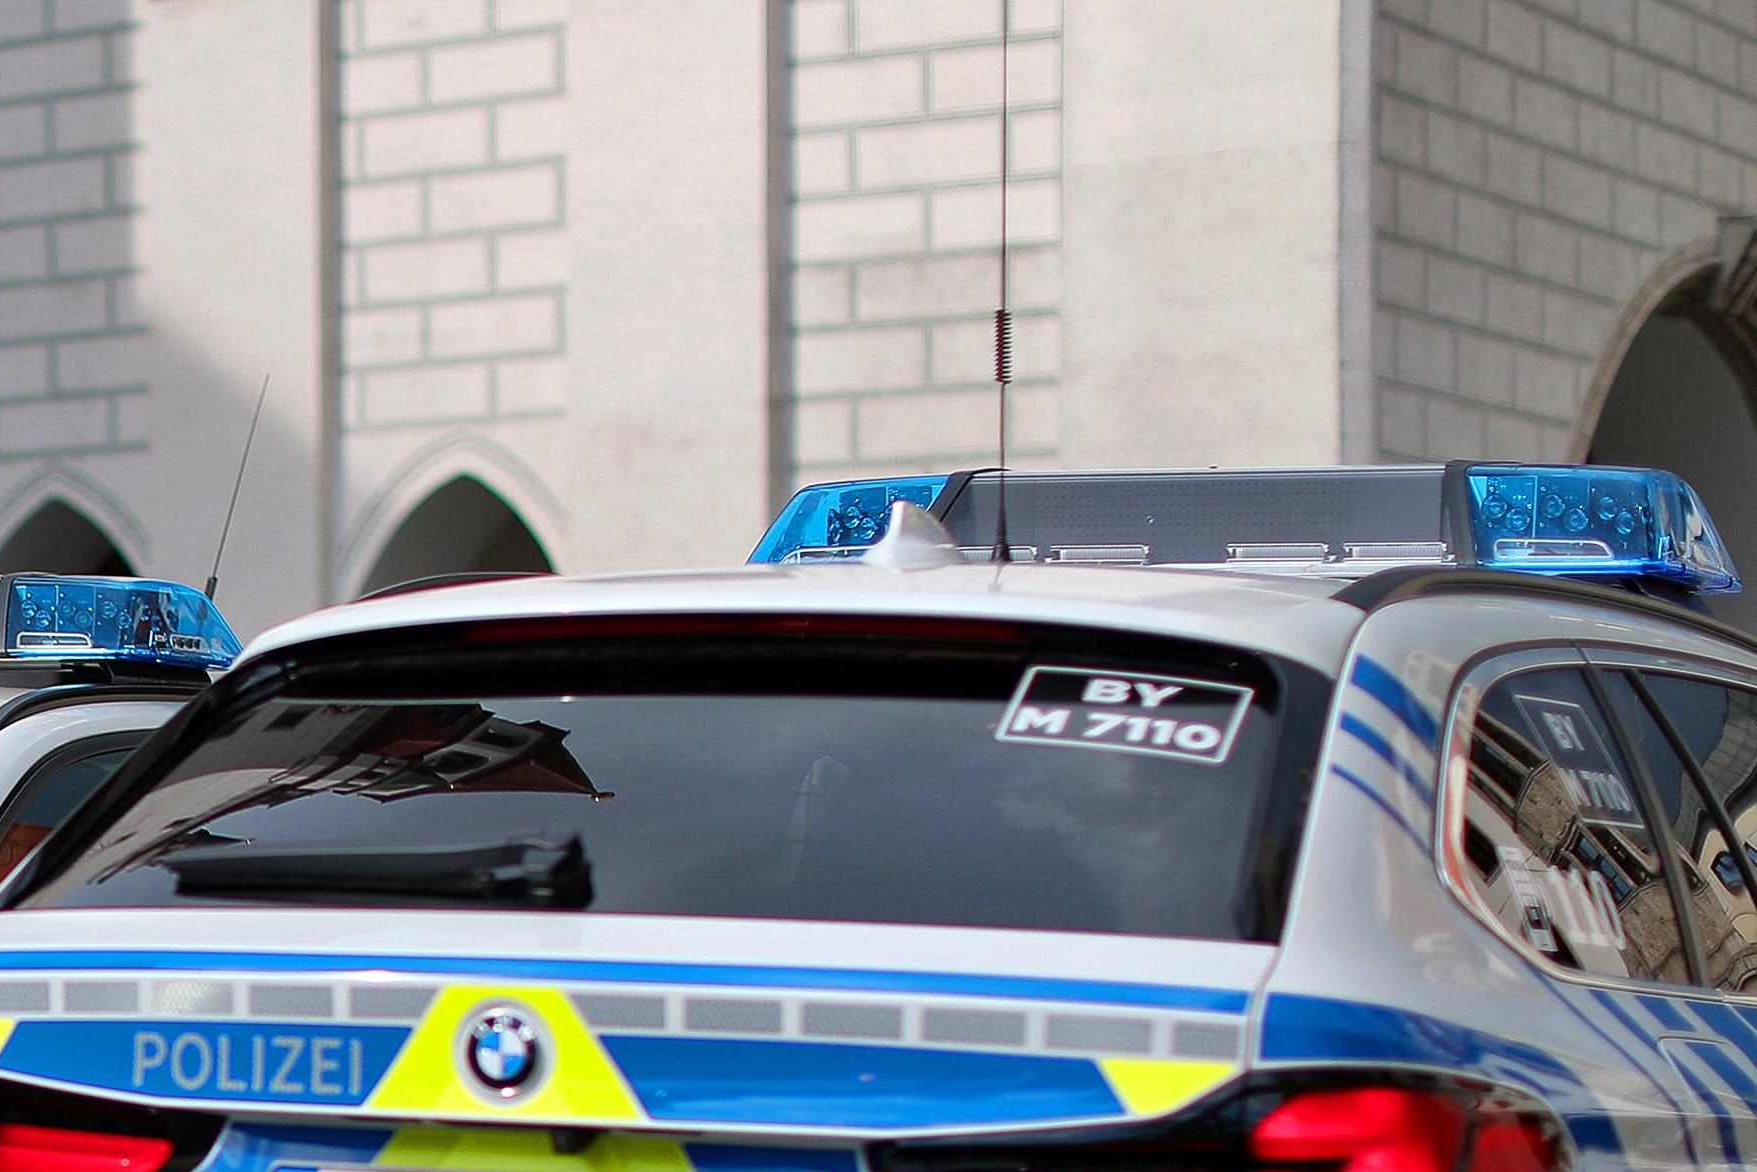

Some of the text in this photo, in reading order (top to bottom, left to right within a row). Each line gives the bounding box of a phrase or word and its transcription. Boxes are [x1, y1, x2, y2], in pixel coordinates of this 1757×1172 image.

[1082, 678, 1183, 708] BY
[1011, 706, 1221, 750] M 7110
[1543, 712, 1584, 751] BY
[132, 1031, 363, 1095] POLIZEI
